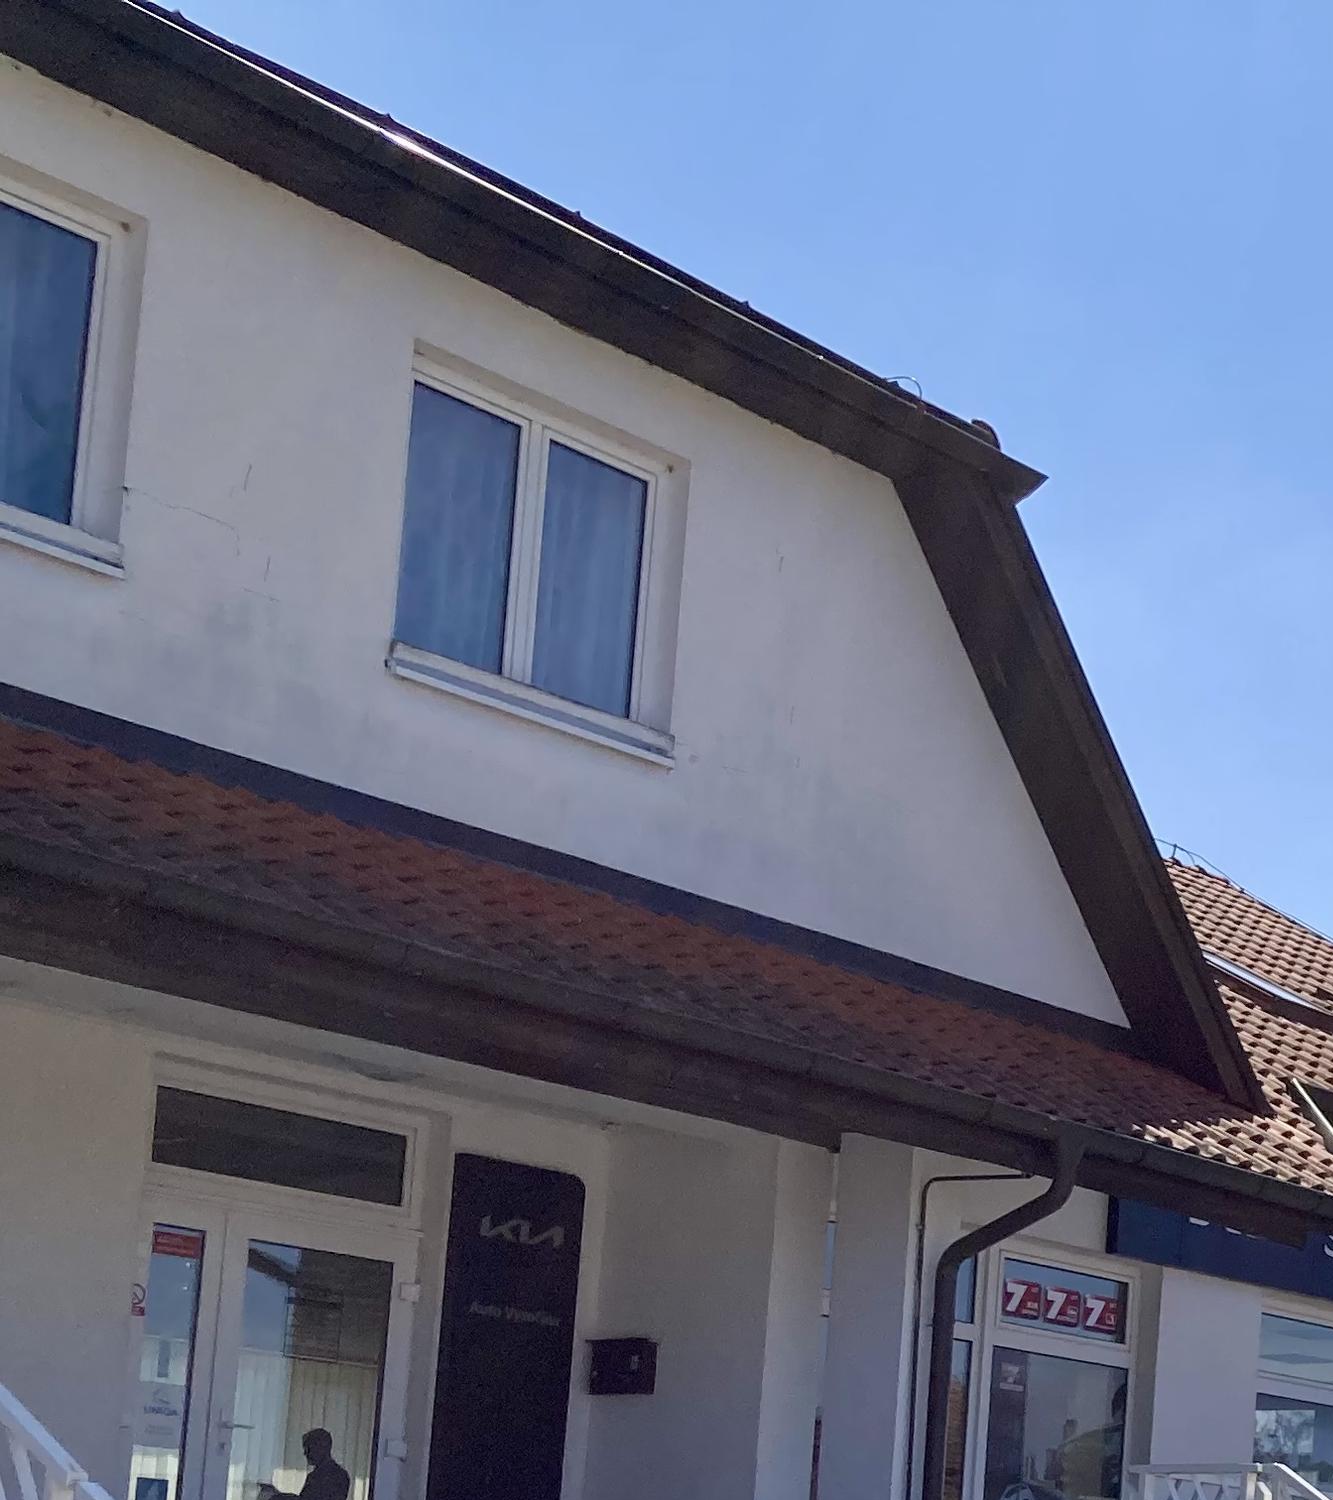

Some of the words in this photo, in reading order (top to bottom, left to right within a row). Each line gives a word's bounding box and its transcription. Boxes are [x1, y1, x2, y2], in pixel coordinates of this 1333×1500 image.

[1006, 1281, 1028, 1312] 7
[1046, 1289, 1067, 1320] 7
[1085, 1297, 1106, 1327] 7
